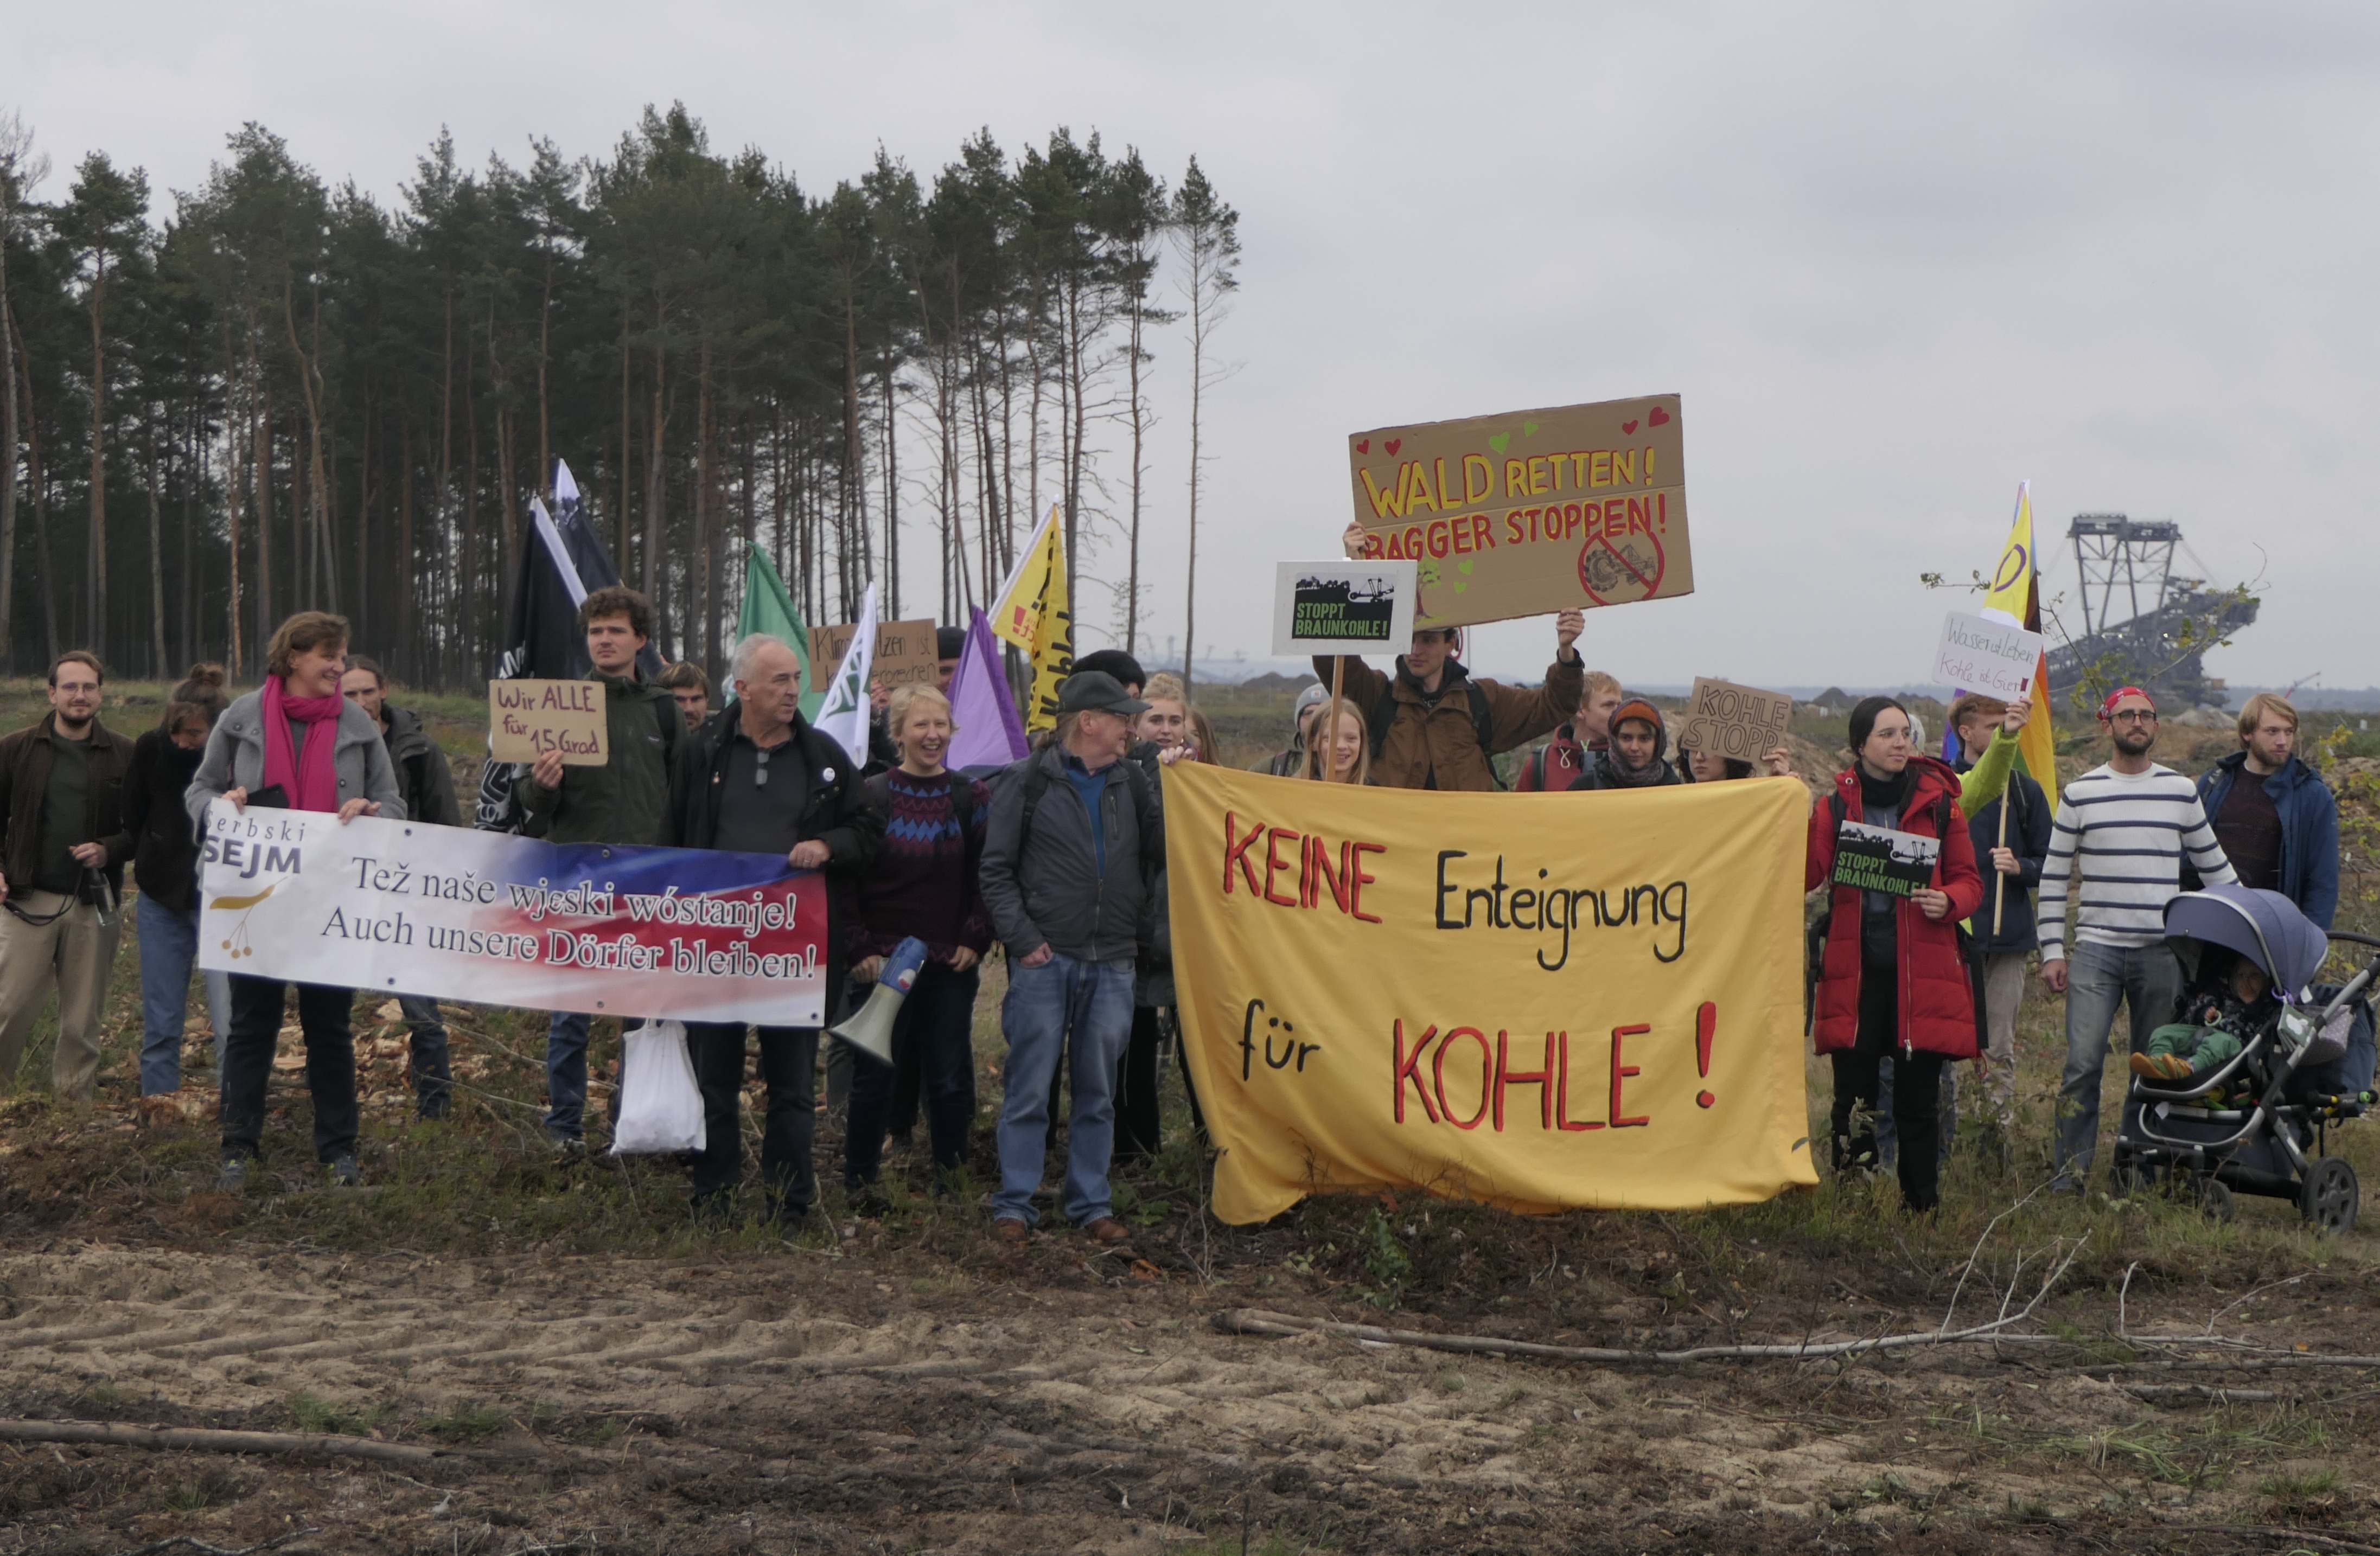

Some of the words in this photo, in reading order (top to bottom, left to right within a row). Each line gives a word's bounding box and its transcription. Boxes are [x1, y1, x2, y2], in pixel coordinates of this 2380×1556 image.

[1359, 453, 1494, 518] WALD
[1504, 490, 1666, 545] STOPPEN!
[1294, 619, 1387, 636] BRAUNKOHLE!
[1297, 603, 1345, 618] STOPPT
[916, 624, 931, 655] ist
[1948, 617, 1990, 650] Wasser
[2000, 633, 2034, 664] Leben
[871, 662, 936, 686] erbrechen
[1939, 652, 1974, 683] Kohle
[1979, 668, 1992, 683] ist
[497, 686, 536, 710] Wir
[541, 685, 596, 712] ALLE
[1698, 686, 1789, 731] KOHLE
[502, 713, 528, 735] für
[558, 729, 599, 754] Grad
[1684, 718, 1778, 760] STOPP
[204, 835, 301, 879] SEJM
[1837, 851, 1887, 874] STOPPT
[352, 857, 412, 894] Tež
[423, 870, 496, 904] naše
[624, 886, 797, 938] wóstanje!
[1224, 810, 1387, 924] KEINE
[1435, 850, 1687, 971] Enteignung
[321, 905, 413, 945] Auch
[427, 925, 538, 961] unsere
[545, 928, 663, 972] Dörfer
[670, 937, 817, 979] bleiben!
[1239, 998, 1321, 1081] für
